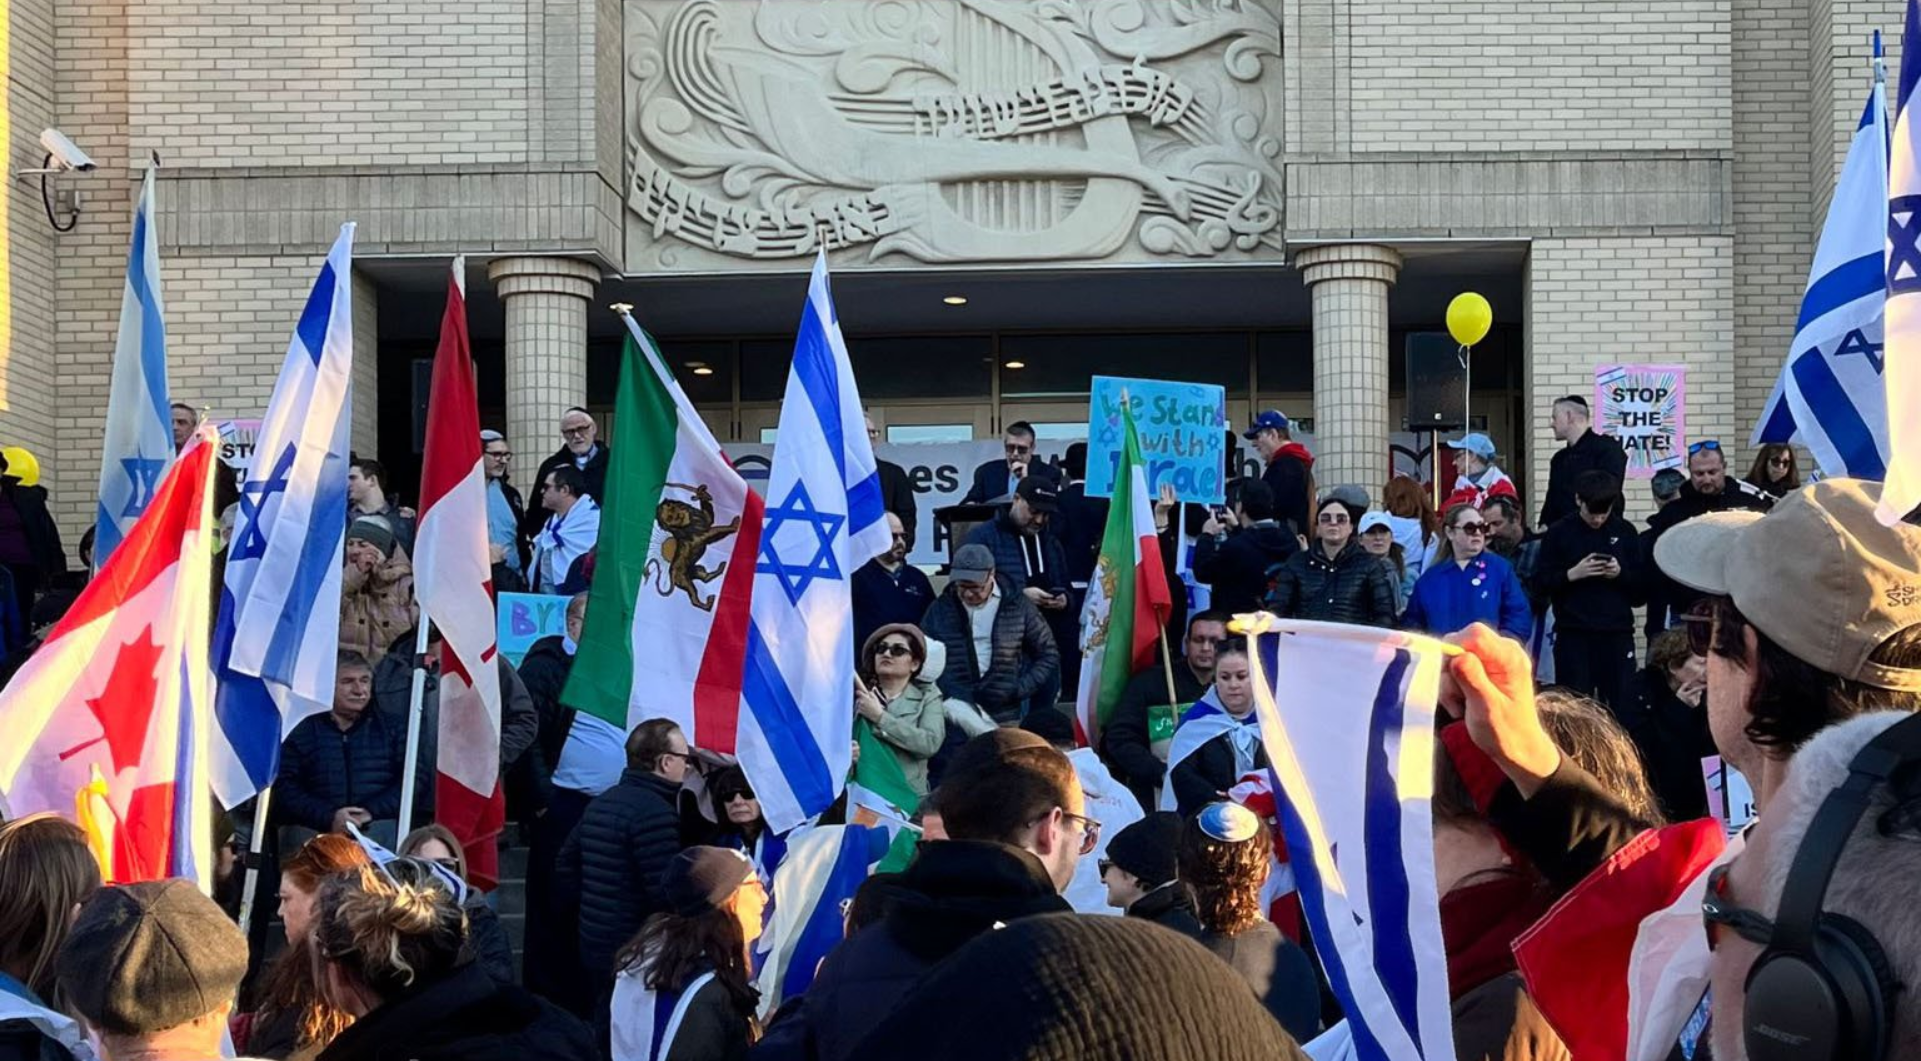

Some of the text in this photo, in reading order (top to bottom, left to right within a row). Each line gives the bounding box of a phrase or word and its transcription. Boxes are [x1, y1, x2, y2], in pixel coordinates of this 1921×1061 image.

[1612, 387, 1668, 403] STOP
[1151, 391, 1225, 427] Stand
[1618, 411, 1662, 427] THE
[1141, 428, 1204, 457] with
[1619, 435, 1671, 451] ATE!
[1106, 450, 1224, 498] Irael
